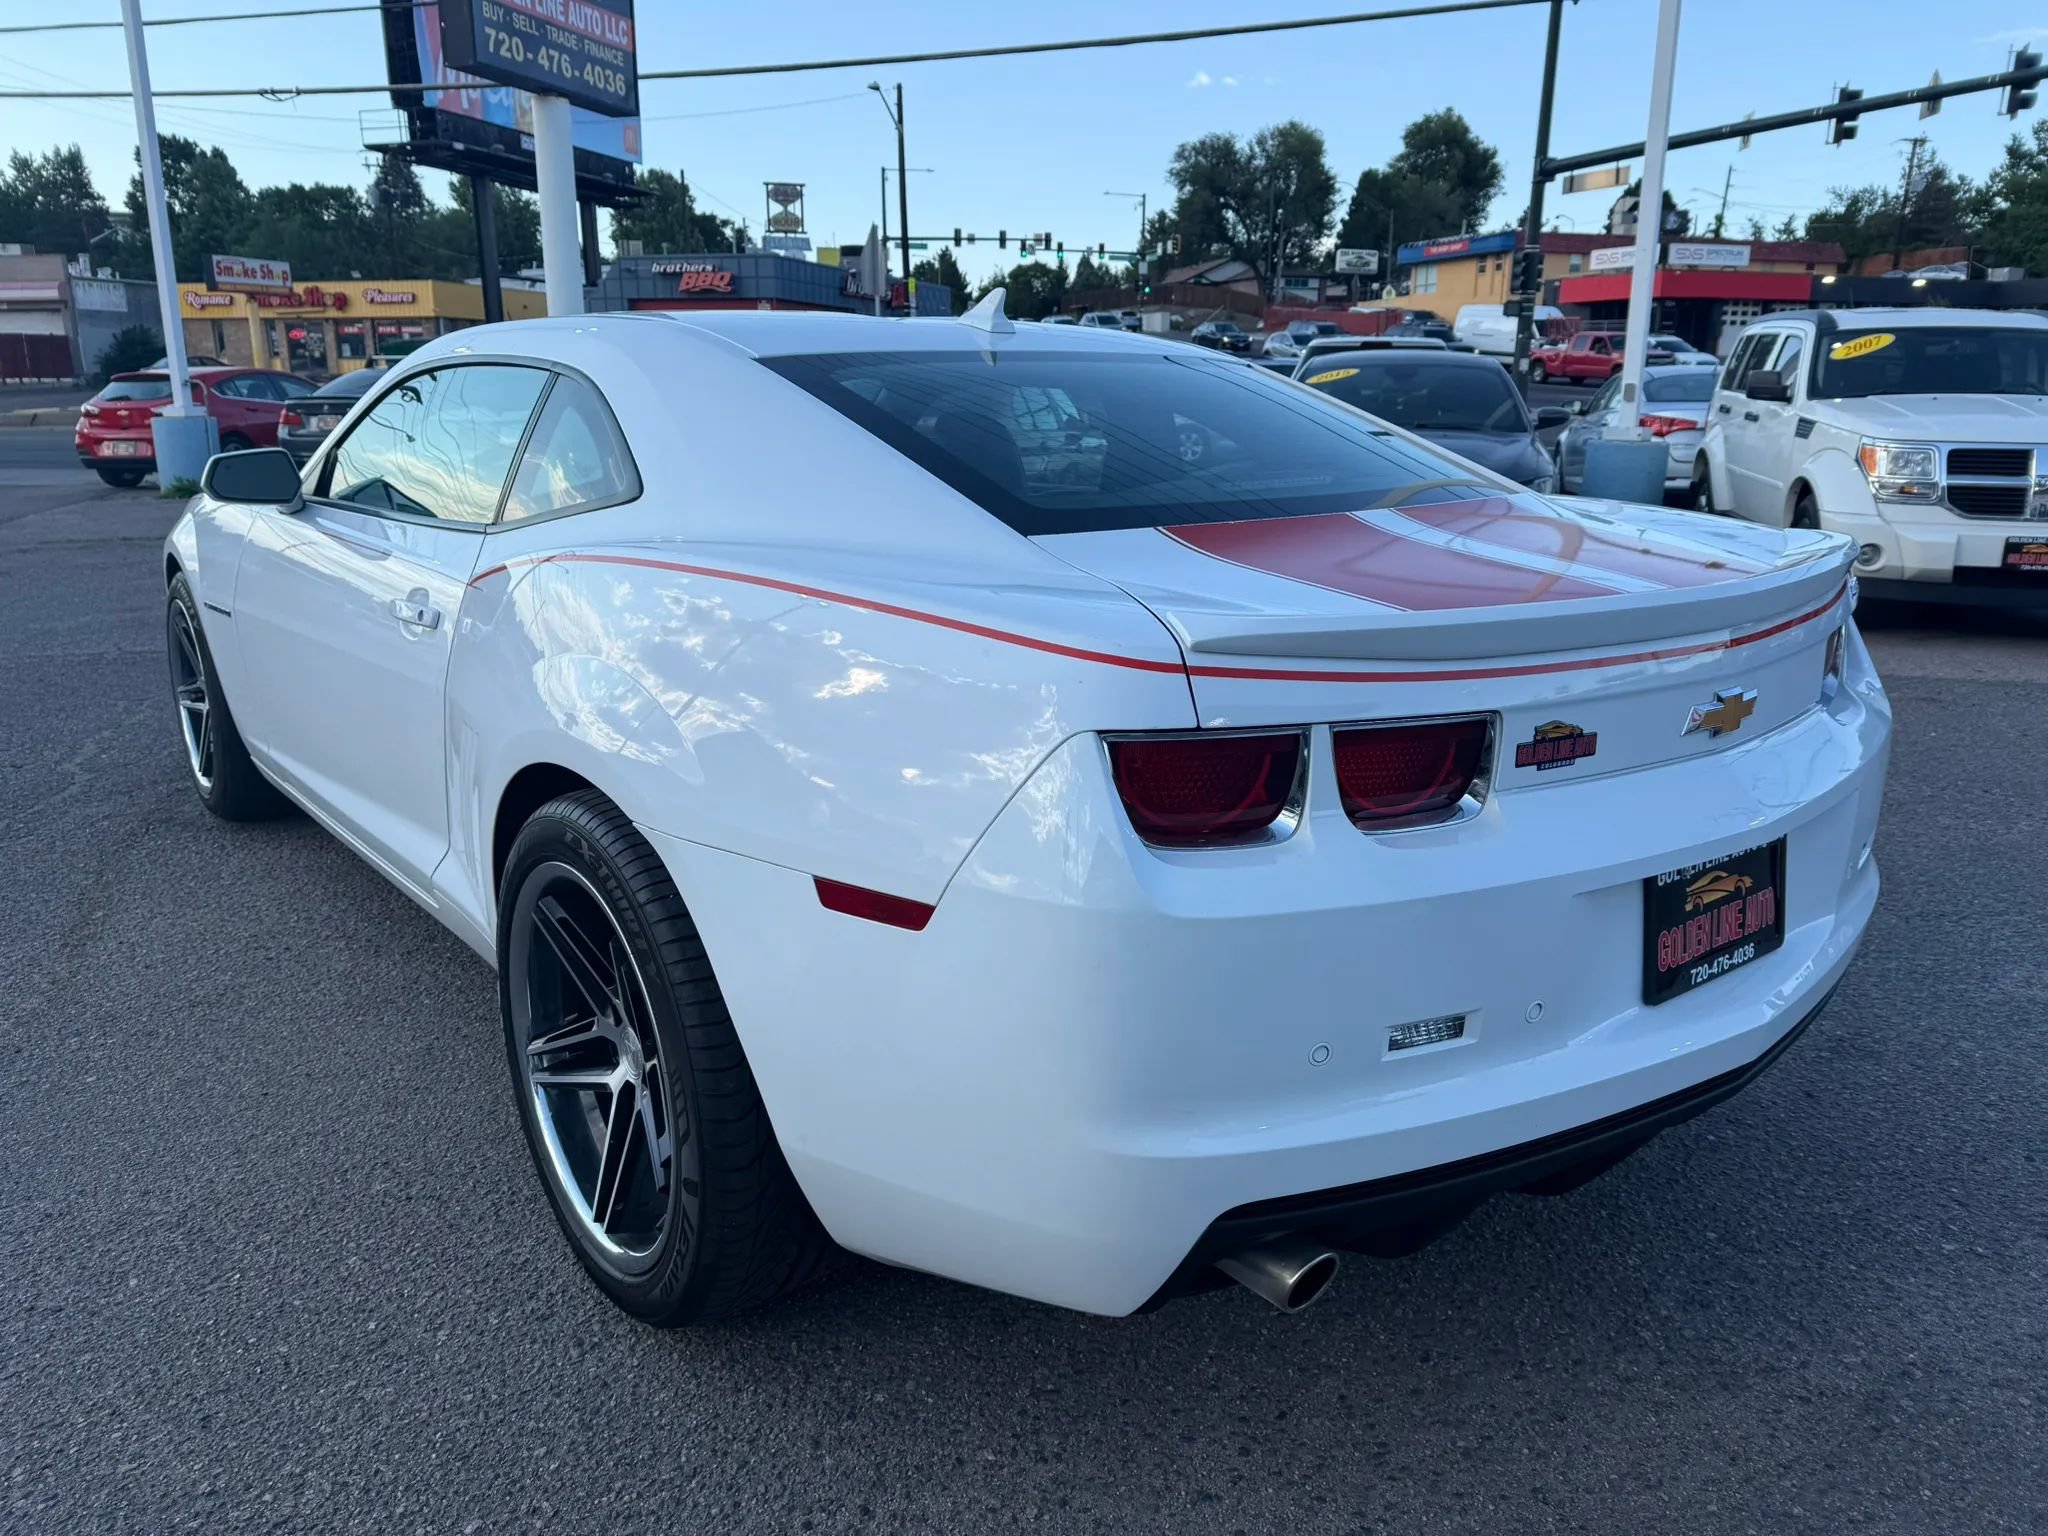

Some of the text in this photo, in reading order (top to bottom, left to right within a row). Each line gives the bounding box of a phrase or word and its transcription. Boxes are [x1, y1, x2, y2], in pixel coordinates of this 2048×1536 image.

[568, 1, 601, 35] AUTO
[604, 12, 628, 45] LLC
[482, 2, 504, 23] BUY
[512, 12, 539, 36] SELL
[546, 25, 578, 49] TRADE
[584, 40, 624, 67] FINANCE
[215, 260, 257, 280] Smoke
[651, 262, 713, 273] brothers
[678, 272, 732, 293] BBQ
[184, 291, 232, 309] Romance
[364, 288, 415, 304] Pleasures
[1843, 336, 1882, 356] 2007
[1517, 735, 1596, 765] GOLDEN LINE AUTO
[1657, 886, 1776, 972] GOLDEN LINE AUTO
[1690, 943, 1755, 985] 720-476-4036
